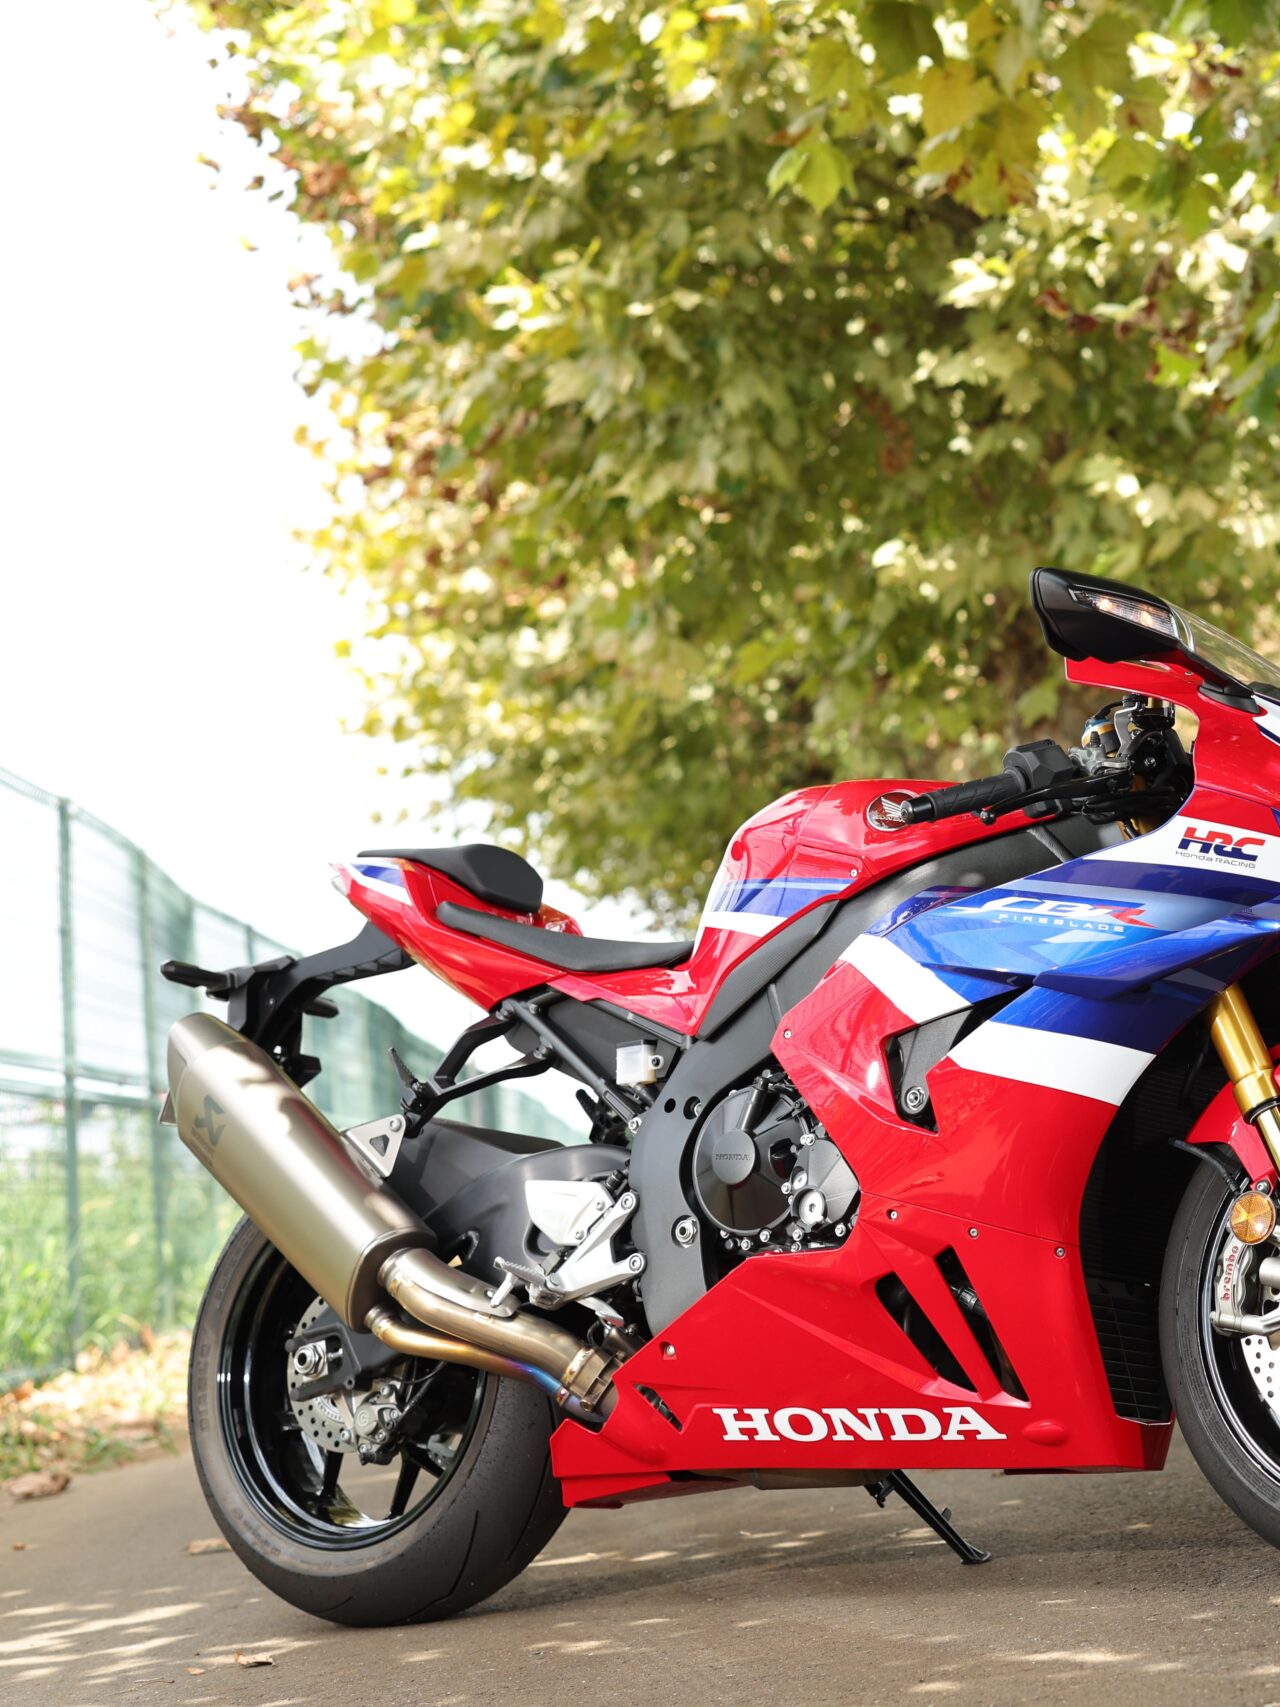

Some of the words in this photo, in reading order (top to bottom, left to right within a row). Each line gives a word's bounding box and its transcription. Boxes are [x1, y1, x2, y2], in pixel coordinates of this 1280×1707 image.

[1178, 826, 1266, 862] HRC
[1215, 857, 1256, 869] RACING
[998, 913, 1125, 933] FIREBLADE
[715, 1153, 751, 1161] HONDA
[1221, 1245, 1239, 1301] brembo
[712, 1407, 1008, 1442] HONDA
